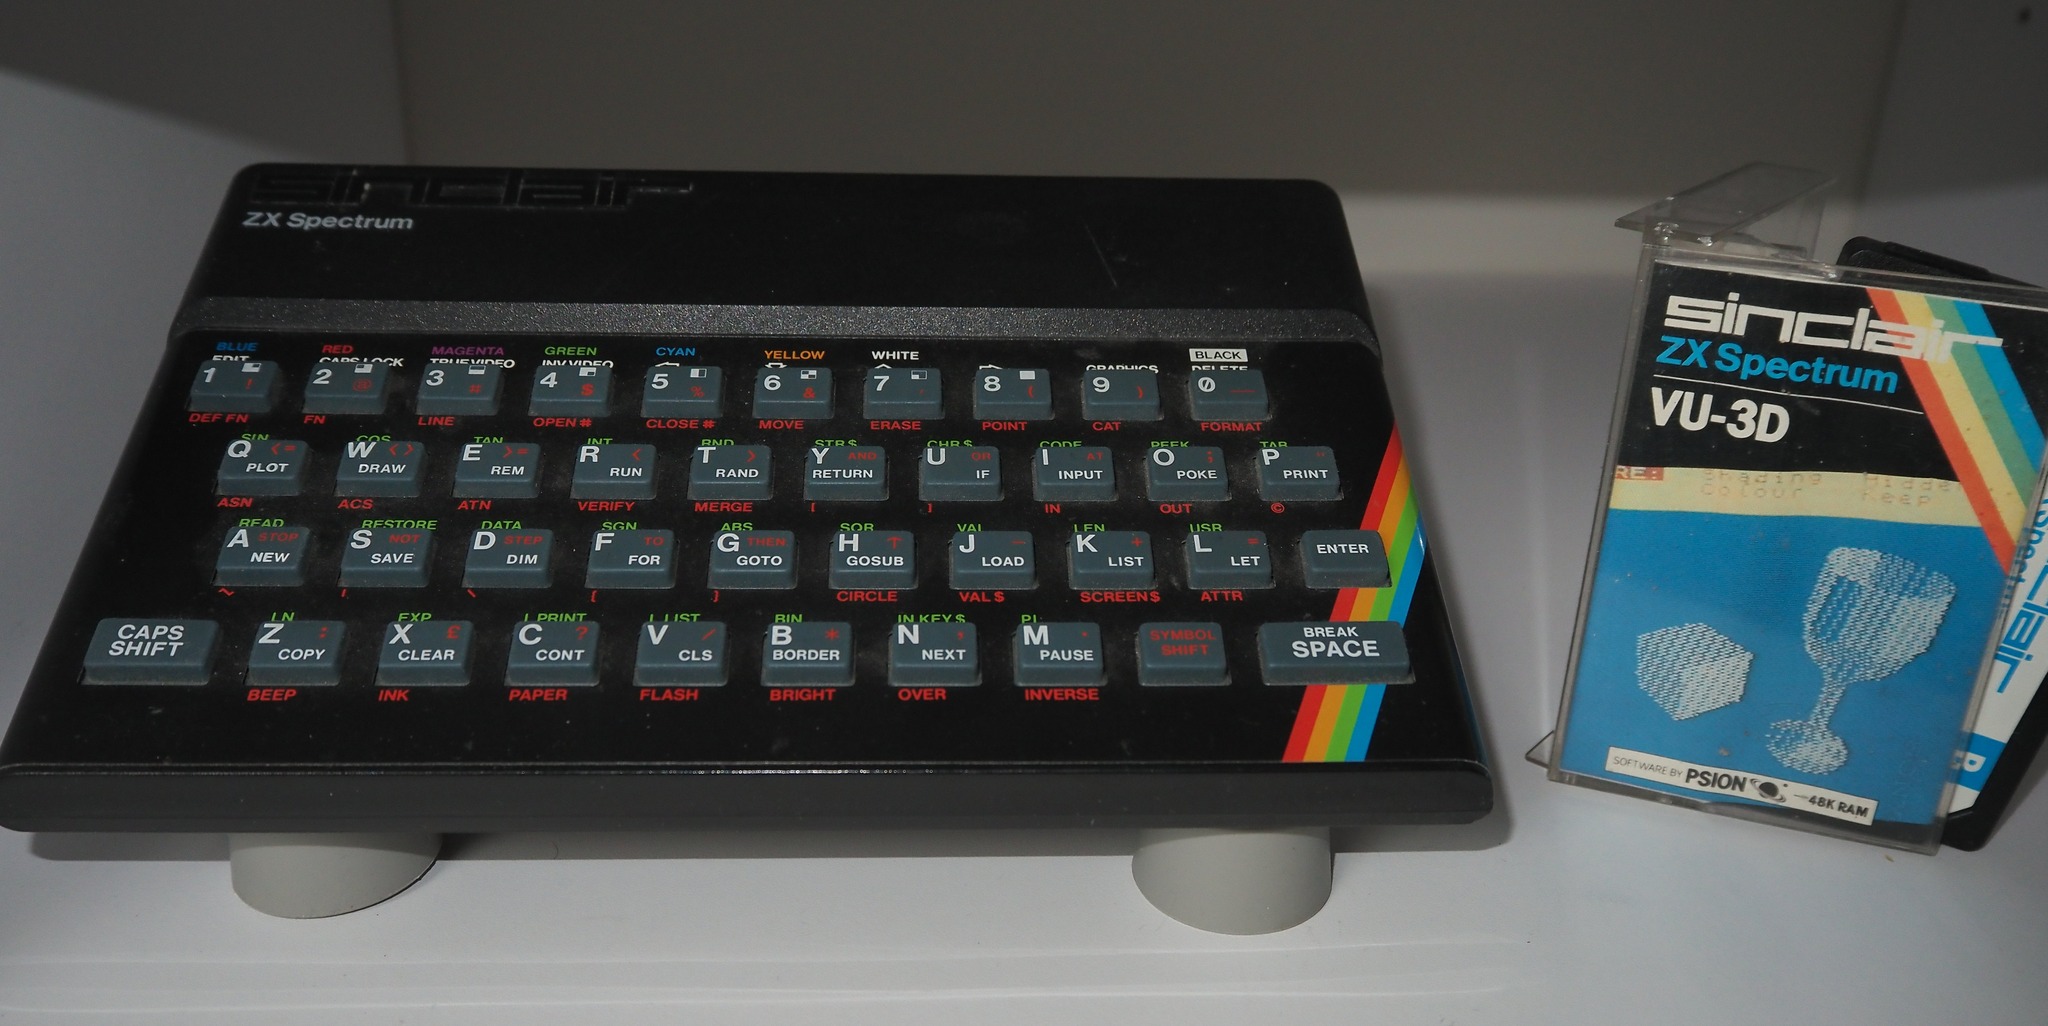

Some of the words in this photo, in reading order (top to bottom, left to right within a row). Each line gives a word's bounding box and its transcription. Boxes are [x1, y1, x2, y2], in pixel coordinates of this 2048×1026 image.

[243, 212, 281, 227] ZX
[287, 213, 413, 230] Spectrum
[1664, 292, 2003, 363] sinclair
[216, 342, 257, 352] BLUE
[322, 344, 353, 354] RED
[432, 346, 504, 356] MAGENTA
[544, 346, 597, 356] GREEN
[655, 347, 695, 356] CYAN
[764, 350, 825, 360] YELLOW
[872, 351, 919, 360] WHITE
[1195, 351, 1241, 359] BLACK
[1655, 335, 1712, 368] ZX
[1714, 342, 1898, 394] Spectrum
[204, 368, 215, 382] 1
[313, 369, 332, 384] 2
[426, 370, 444, 385] 3
[540, 372, 557, 387] 4
[652, 374, 668, 389] 5
[764, 375, 780, 390] 6
[874, 376, 889, 391] 7
[984, 376, 1000, 391] 8
[1093, 377, 1109, 392] 9
[189, 413, 222, 422] DEF
[226, 414, 249, 423] FN
[304, 415, 326, 424] FN
[1651, 387, 1790, 443] VU-3D
[418, 416, 454, 426] LINE
[533, 418, 576, 427] OPEN
[646, 419, 698, 429] CLOSE
[759, 420, 803, 429] MOVE
[870, 420, 920, 430] ERASE
[982, 422, 1027, 431] POINT
[1092, 422, 1120, 431] CAT
[1201, 422, 1261, 431] FORMAT
[228, 440, 251, 457] Q
[348, 442, 376, 458] W
[463, 444, 482, 460] E
[580, 446, 599, 462] R
[698, 447, 716, 463] T
[812, 448, 829, 464] Y
[849, 452, 876, 460] AND
[928, 448, 945, 465] U
[971, 452, 991, 460] OR
[1043, 449, 1048, 465] I
[1088, 452, 1102, 460] AT
[1153, 449, 1174, 465] O
[1262, 449, 1279, 465] P
[246, 463, 289, 472] PLOT
[359, 464, 406, 473] DRAW
[491, 466, 524, 475] REM
[610, 468, 642, 476] RUN
[716, 469, 758, 477] RAND
[813, 470, 872, 478] RETURN
[977, 470, 989, 478] IF
[1059, 471, 1103, 479] INPUT
[1177, 470, 1217, 479] POKE
[1283, 470, 1328, 478] PRINT
[218, 497, 253, 507] ASN
[338, 499, 373, 509] ACS
[458, 500, 491, 510] ATN
[578, 502, 634, 511] VERIFY
[695, 502, 751, 512] MERGE
[1045, 504, 1060, 513] IN
[1159, 503, 1191, 514] OUT
[227, 529, 248, 547] A
[259, 532, 299, 542] STOP
[351, 530, 372, 549] S
[389, 534, 420, 543] NOT
[474, 532, 495, 549] D
[505, 536, 543, 544] STEP
[595, 533, 614, 550] F
[645, 536, 664, 546] TO
[748, 537, 786, 546] THEN
[717, 533, 739, 552] G
[839, 534, 858, 551] H
[960, 535, 974, 553] J
[1077, 535, 1097, 552] K
[1194, 535, 1212, 552] L
[1317, 544, 1368, 553] ENTER
[251, 553, 290, 562] NEW
[371, 554, 414, 563] SAVE
[507, 555, 537, 564] DIM
[629, 555, 660, 565] FOR
[737, 556, 782, 565] GOTO
[847, 556, 903, 566] GOSUB
[982, 557, 1024, 566] LOAD
[1109, 557, 1143, 566] LIST
[1231, 557, 1260, 565] LET
[836, 591, 896, 602] CIRCLE
[960, 592, 990, 602] VAL
[1201, 590, 1243, 601] ATTR
[118, 625, 184, 640] CAPS
[259, 623, 284, 643] Z
[389, 624, 413, 644] X
[519, 624, 542, 645] C
[648, 625, 668, 644] V
[772, 626, 792, 645] B
[898, 625, 919, 644] N
[1024, 625, 1048, 645] M
[1151, 630, 1215, 640] SYMBOL
[1304, 627, 1358, 637] BREAK
[109, 641, 183, 656] SHIFT
[1162, 644, 1207, 656] SHIFT
[1292, 640, 1379, 657] SPACE
[279, 649, 325, 660] COPY
[399, 650, 454, 660] CLEAR
[536, 650, 584, 660] CONT
[679, 650, 712, 661] CLS
[773, 650, 839, 660] BORDER
[922, 650, 965, 660] NEXT
[1040, 650, 1093, 660] PAUSE
[248, 689, 296, 701] BEEP
[379, 690, 408, 700] INK
[509, 689, 567, 700] PAPER
[640, 689, 698, 700] FLASH
[770, 688, 835, 701] BRIGHT
[898, 688, 946, 700] OVER
[1025, 688, 1098, 700] INVERSE
[1613, 756, 1668, 775] SOFTWARE
[1670, 768, 1683, 778] BY
[1686, 768, 1748, 792] PSION
[1837, 801, 1868, 818] RAM
